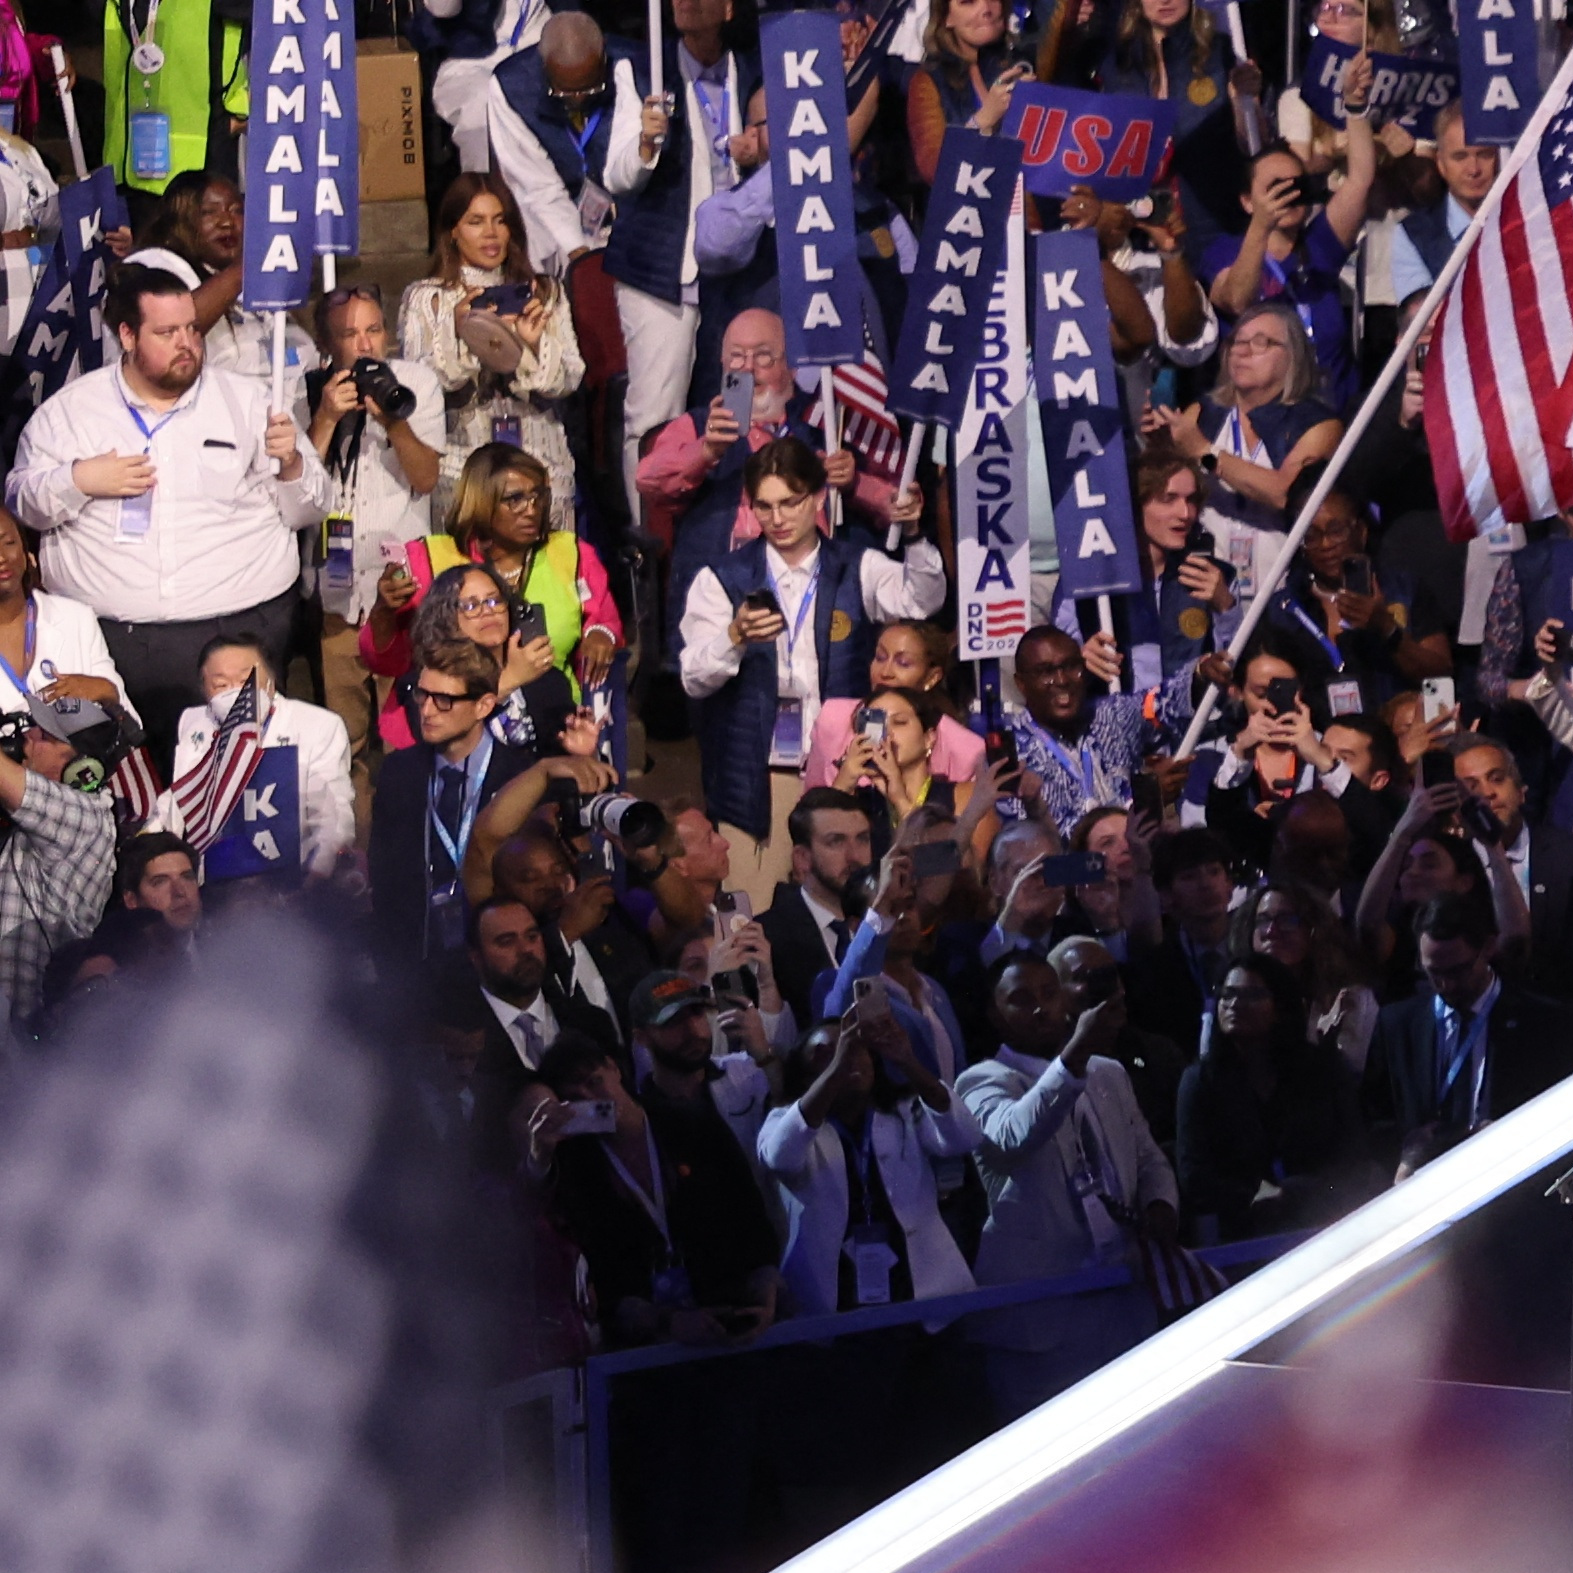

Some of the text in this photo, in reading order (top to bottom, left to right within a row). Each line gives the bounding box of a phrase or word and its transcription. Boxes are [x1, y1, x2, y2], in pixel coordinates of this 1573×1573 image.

[1319, 53, 1456, 107] HRRIS
[401, 86, 415, 164] PIXMOB
[1017, 104, 1153, 178] USA
[783, 49, 842, 330] KAMALA
[910, 160, 996, 394] KAMALA
[1042, 269, 1118, 558] KAMALA
[968, 602, 983, 652] DNC
